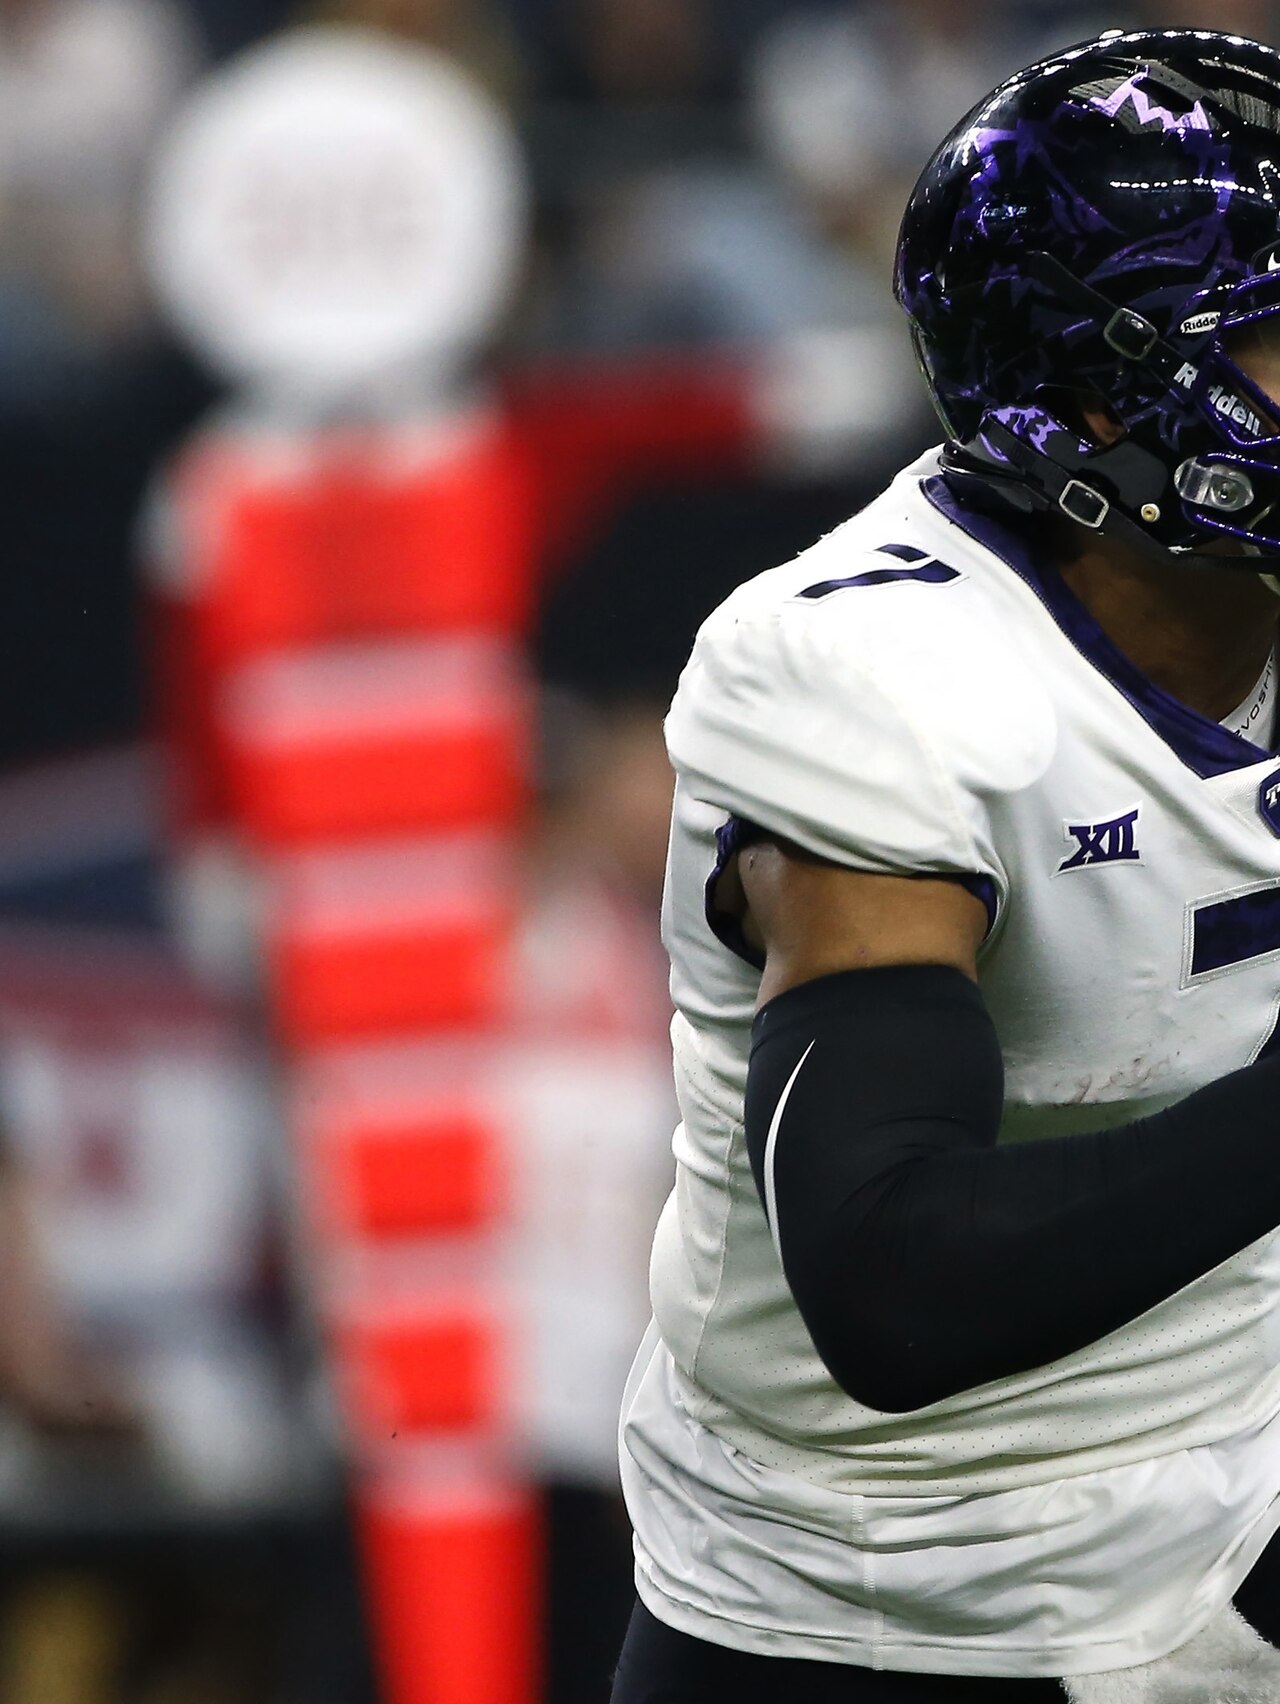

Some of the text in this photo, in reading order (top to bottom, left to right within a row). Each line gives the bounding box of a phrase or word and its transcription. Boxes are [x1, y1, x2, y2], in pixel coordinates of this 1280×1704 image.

[1184, 314, 1219, 332] Ridde
[1173, 361, 1261, 436] Rddell
[1057, 808, 1140, 872] XII
